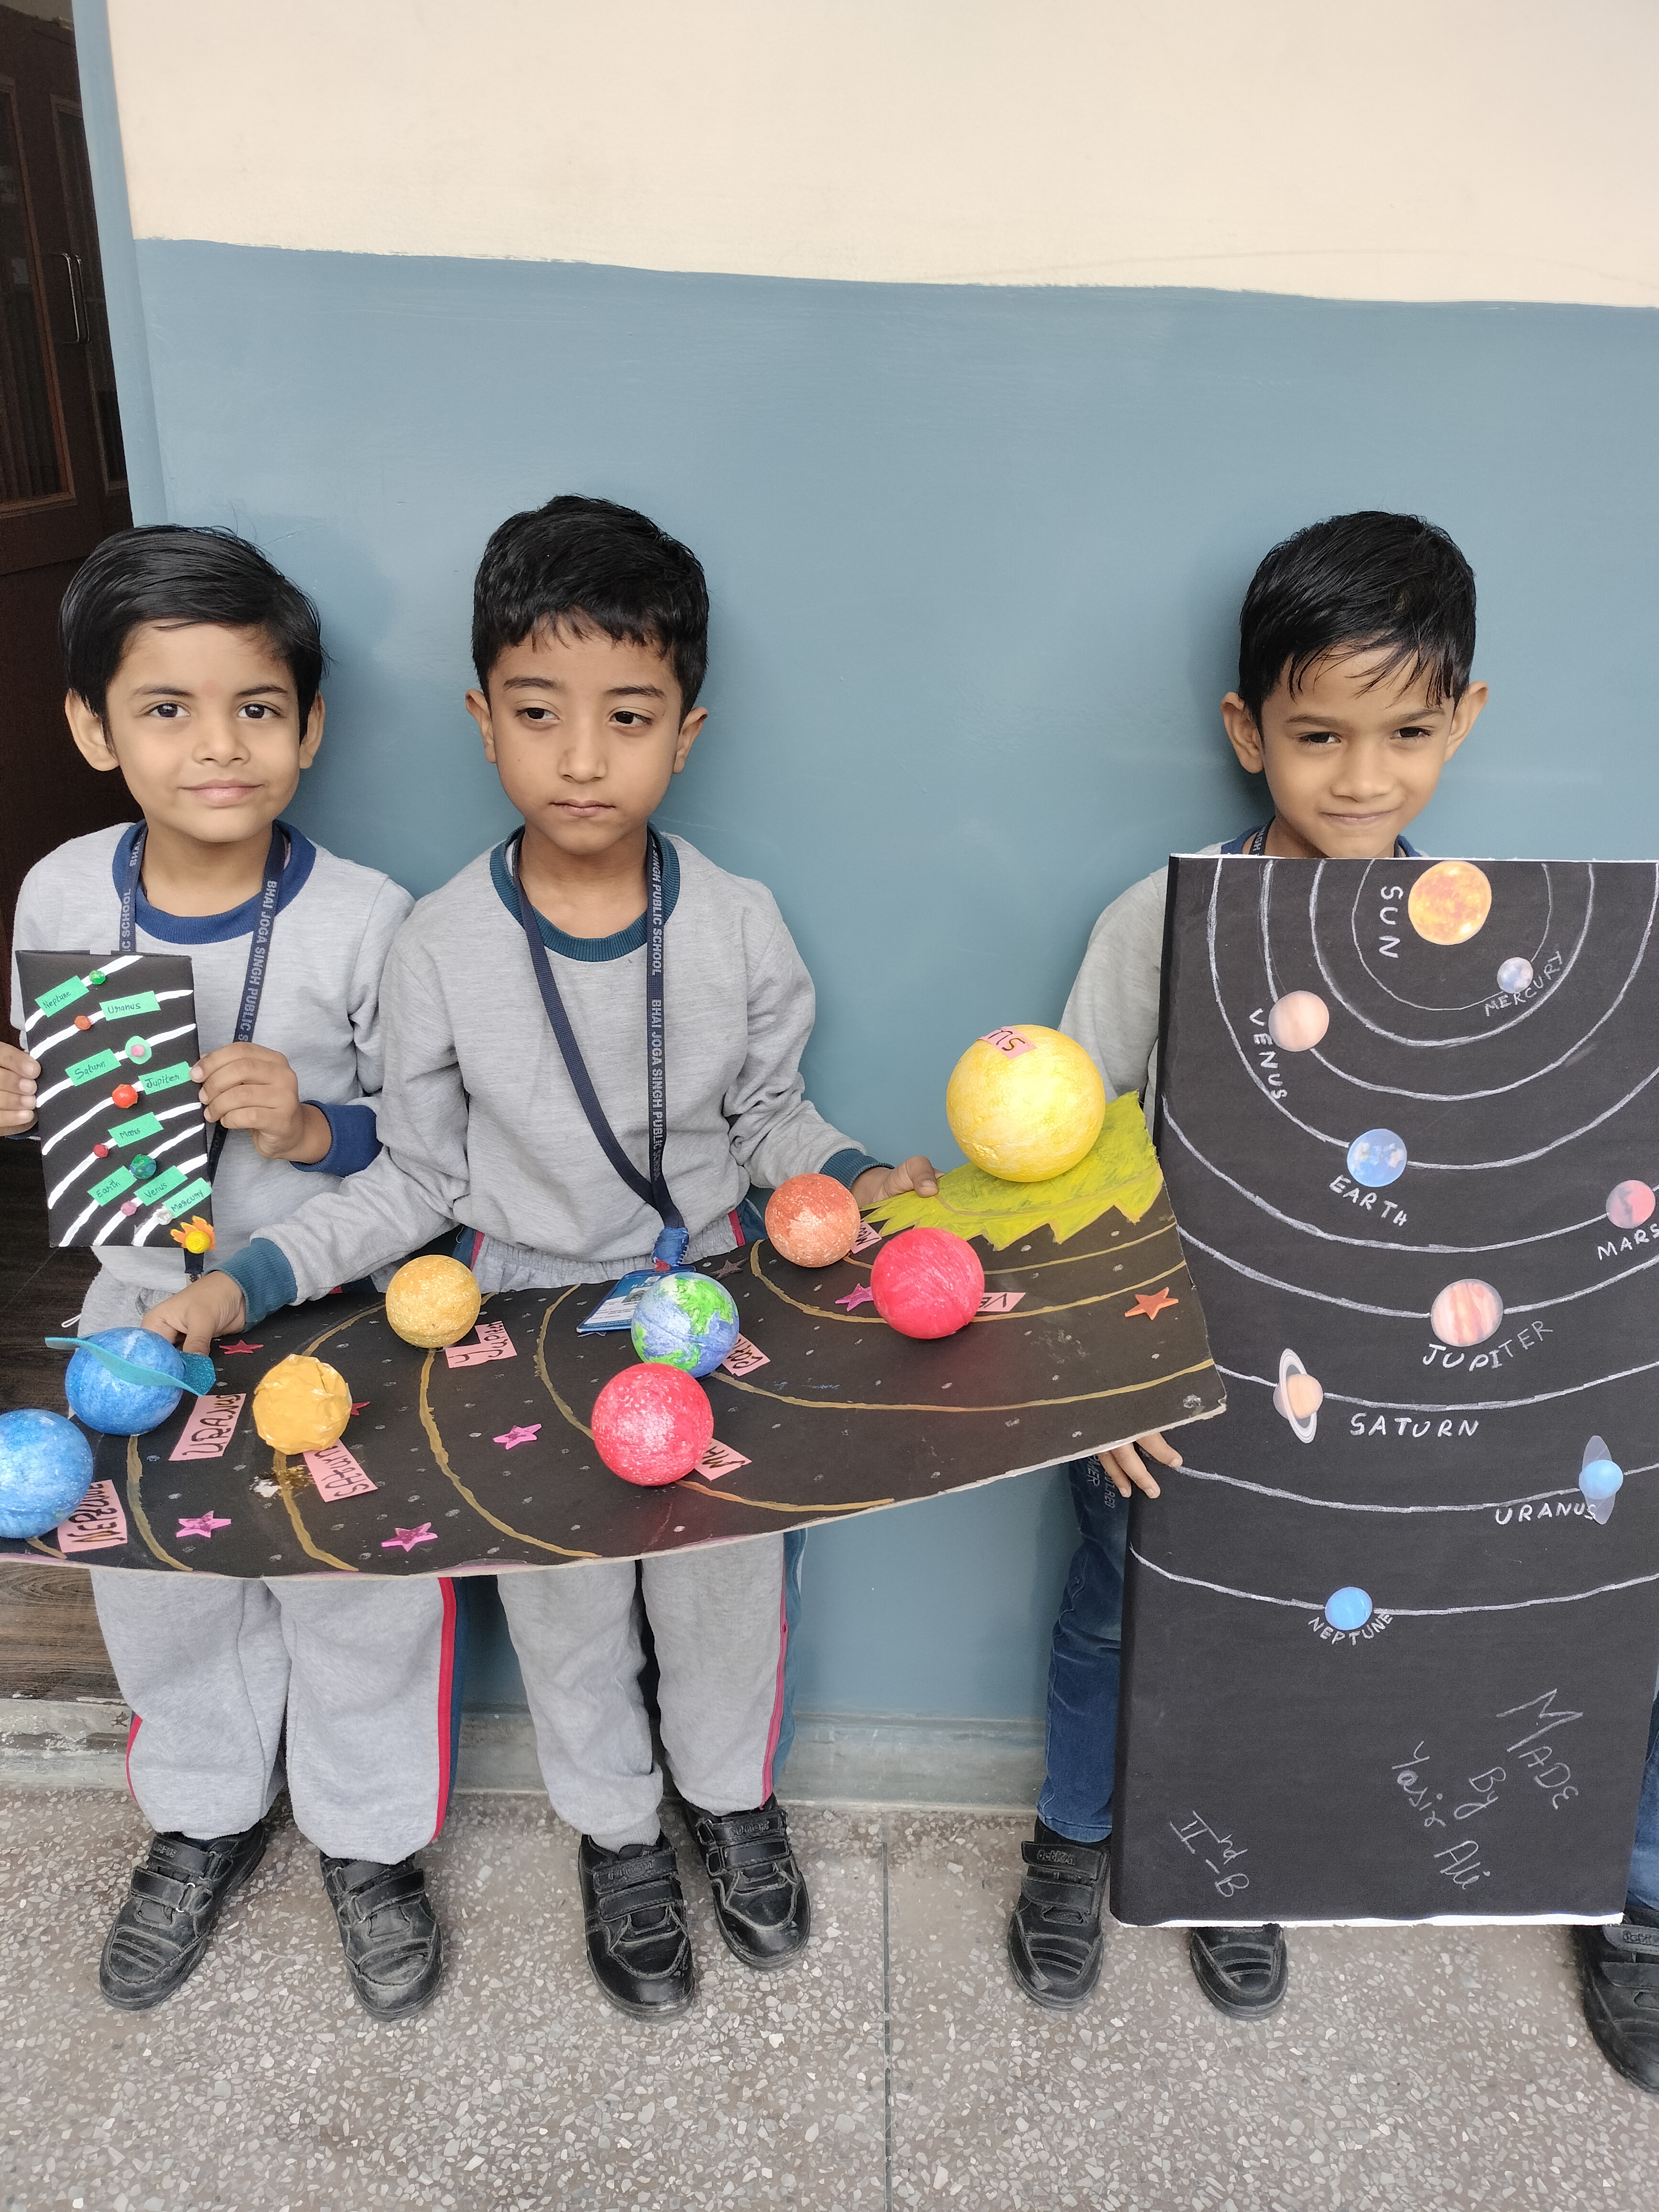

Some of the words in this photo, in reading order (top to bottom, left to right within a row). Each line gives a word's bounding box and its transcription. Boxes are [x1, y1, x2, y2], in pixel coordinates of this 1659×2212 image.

[653, 850, 661, 883] SINGH
[263, 881, 277, 909] BHAI
[652, 884, 662, 926] PUBLIC
[122, 888, 132, 938] SCHOOL
[256, 911, 271, 943] JOGA
[1378, 885, 1404, 958] SUN
[249, 947, 266, 985] SINGH
[652, 929, 662, 977] SCHOOL
[42, 991, 71, 1009] Neptune
[1484, 951, 1563, 1017] MERCURY
[107, 1003, 142, 1014] Uranus
[240, 987, 259, 1032] PUBLIC
[652, 999, 662, 1029] BHAI
[652, 1031, 662, 1066] JOGA
[987, 1028, 1026, 1051] SU
[1249, 1008, 1288, 1099] VENUS
[75, 1061, 106, 1080] Saturn
[144, 1073, 181, 1088] Jupiter
[652, 1068, 663, 1108] SINGH
[119, 1127, 141, 1139] Mars
[653, 1111, 663, 1150] PUBLIC
[96, 1179, 121, 1198] Earth
[144, 1182, 167, 1198] Venus
[170, 1189, 204, 1212] Mercury
[1329, 1174, 1407, 1227] EARTH
[1597, 1223, 1659, 1261] MARS
[1422, 1320, 1553, 1371] JUPITER
[1350, 1412, 1479, 1438] SATURN
[1494, 1502, 1596, 1525] URANUS
[1308, 1614, 1394, 1646] NEPTUNE
[1495, 1688, 1583, 1810] MADE
